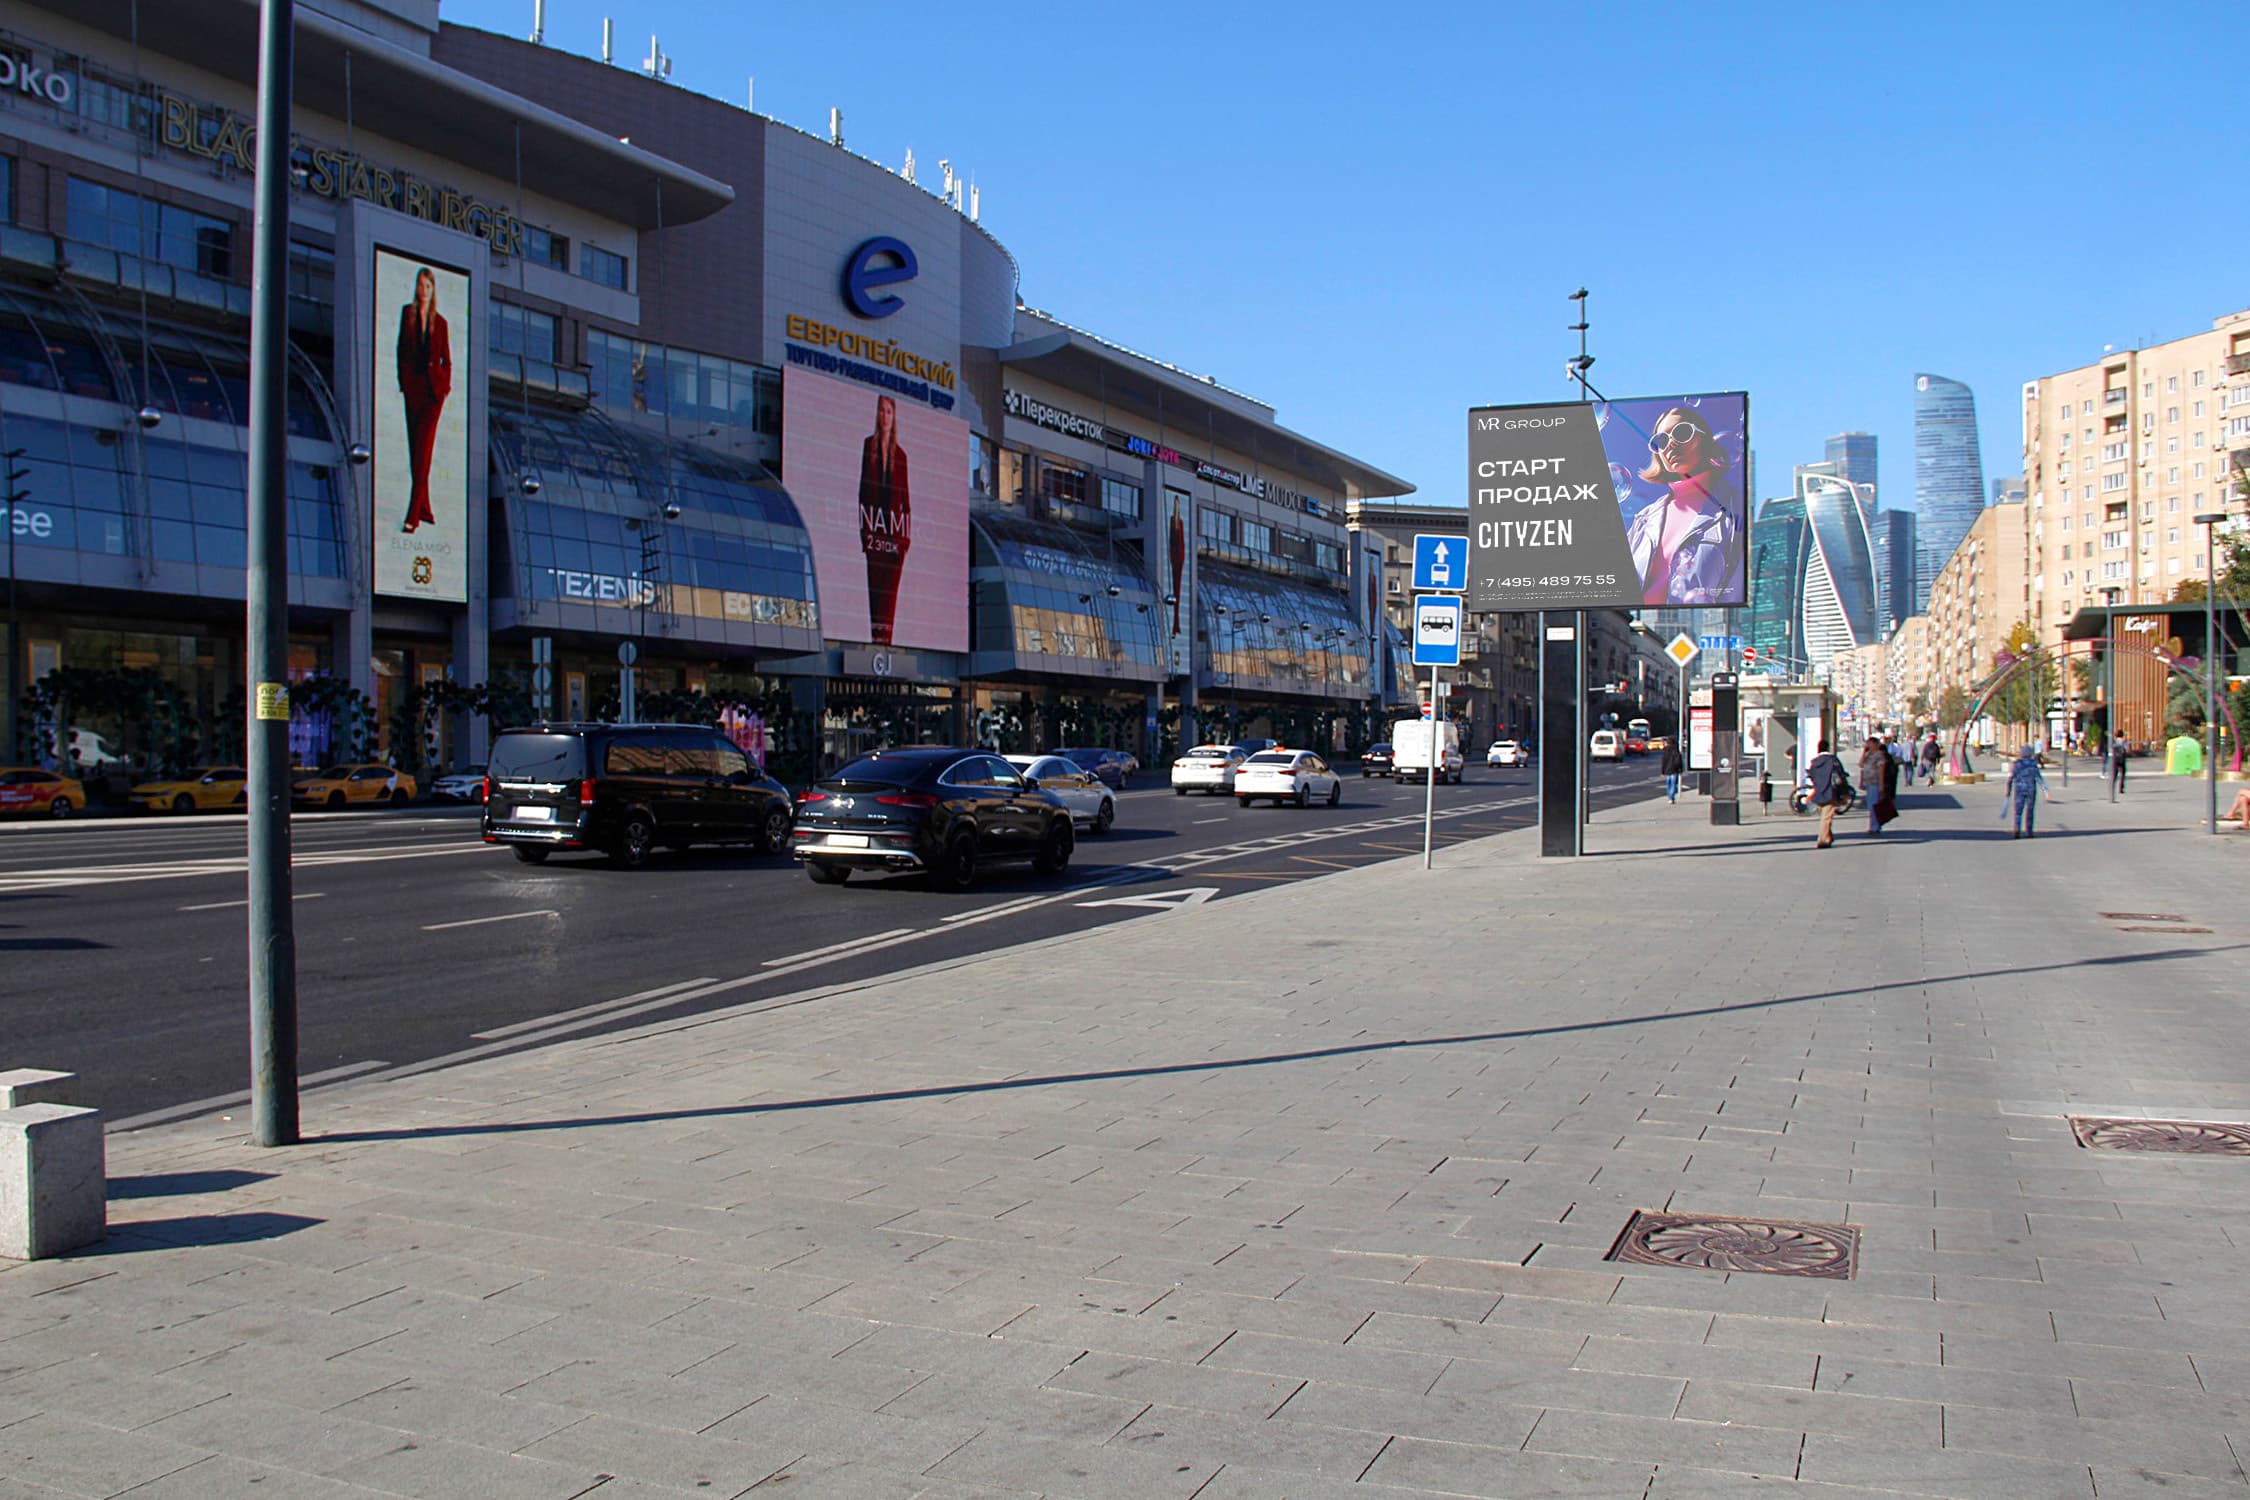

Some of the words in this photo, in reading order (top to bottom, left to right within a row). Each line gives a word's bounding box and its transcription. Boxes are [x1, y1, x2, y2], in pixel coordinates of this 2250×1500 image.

[310, 150, 394, 209] STAR
[787, 313, 956, 391] ЕВРОПЕЙСКИЙ
[1478, 418, 1500, 431] MR
[1504, 417, 1566, 430] GROUP
[1478, 457, 1566, 478] СТАРТ
[1478, 483, 1599, 506] ПРОДАЖ
[1478, 519, 1573, 549] CITYZEN
[548, 568, 654, 604] TEZENIS
[1497, 576, 1536, 588] (495)
[1538, 576, 1570, 586] 489
[1573, 575, 1592, 585] 75
[1595, 574, 1617, 585] 55
